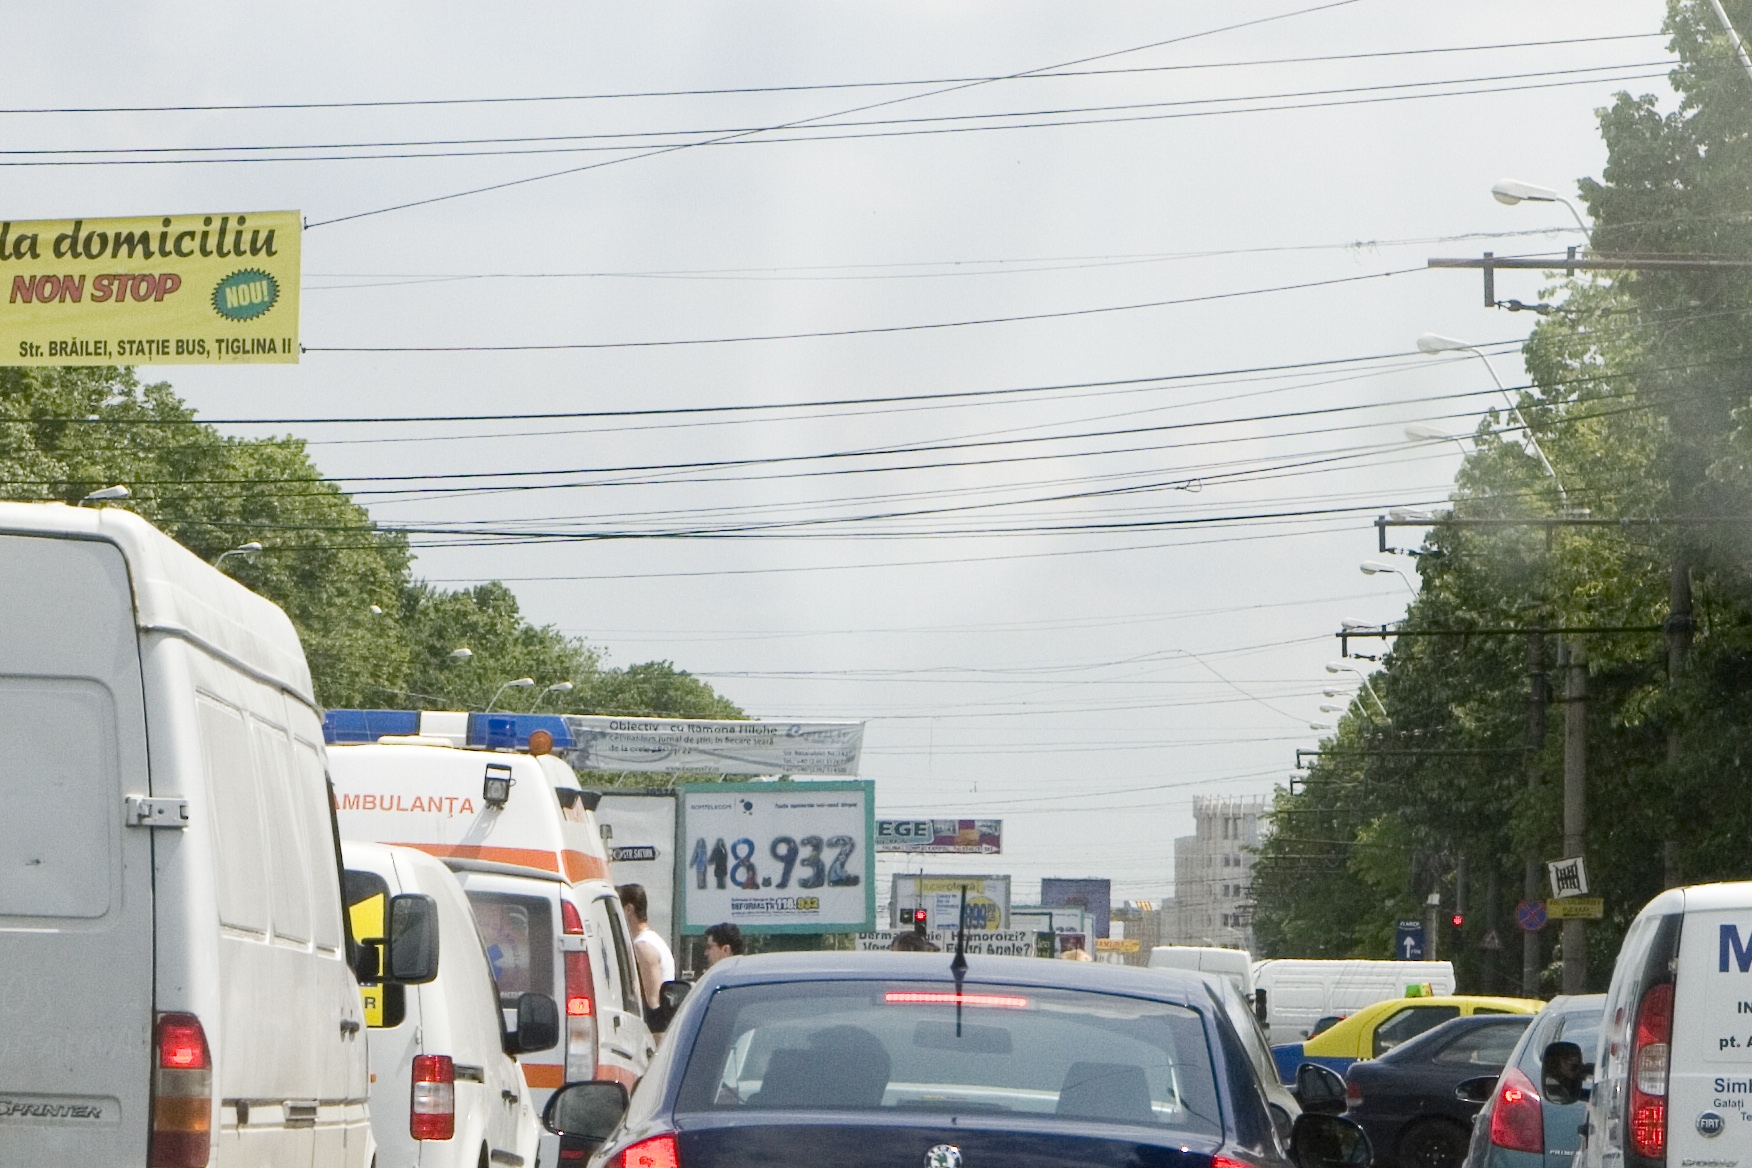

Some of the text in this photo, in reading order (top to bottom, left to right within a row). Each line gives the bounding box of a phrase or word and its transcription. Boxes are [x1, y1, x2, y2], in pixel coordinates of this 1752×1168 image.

[53, 216, 278, 260] domiciliu
[9, 273, 86, 304] NON
[90, 273, 182, 302] STOP
[225, 280, 269, 308] NOU!
[19, 341, 43, 357] Str.
[48, 337, 112, 359] BRĂILEI,
[175, 338, 210, 358] BUS,
[1719, 1036, 1741, 1051] pt.
[1700, 1118, 1720, 1128] FIAT
